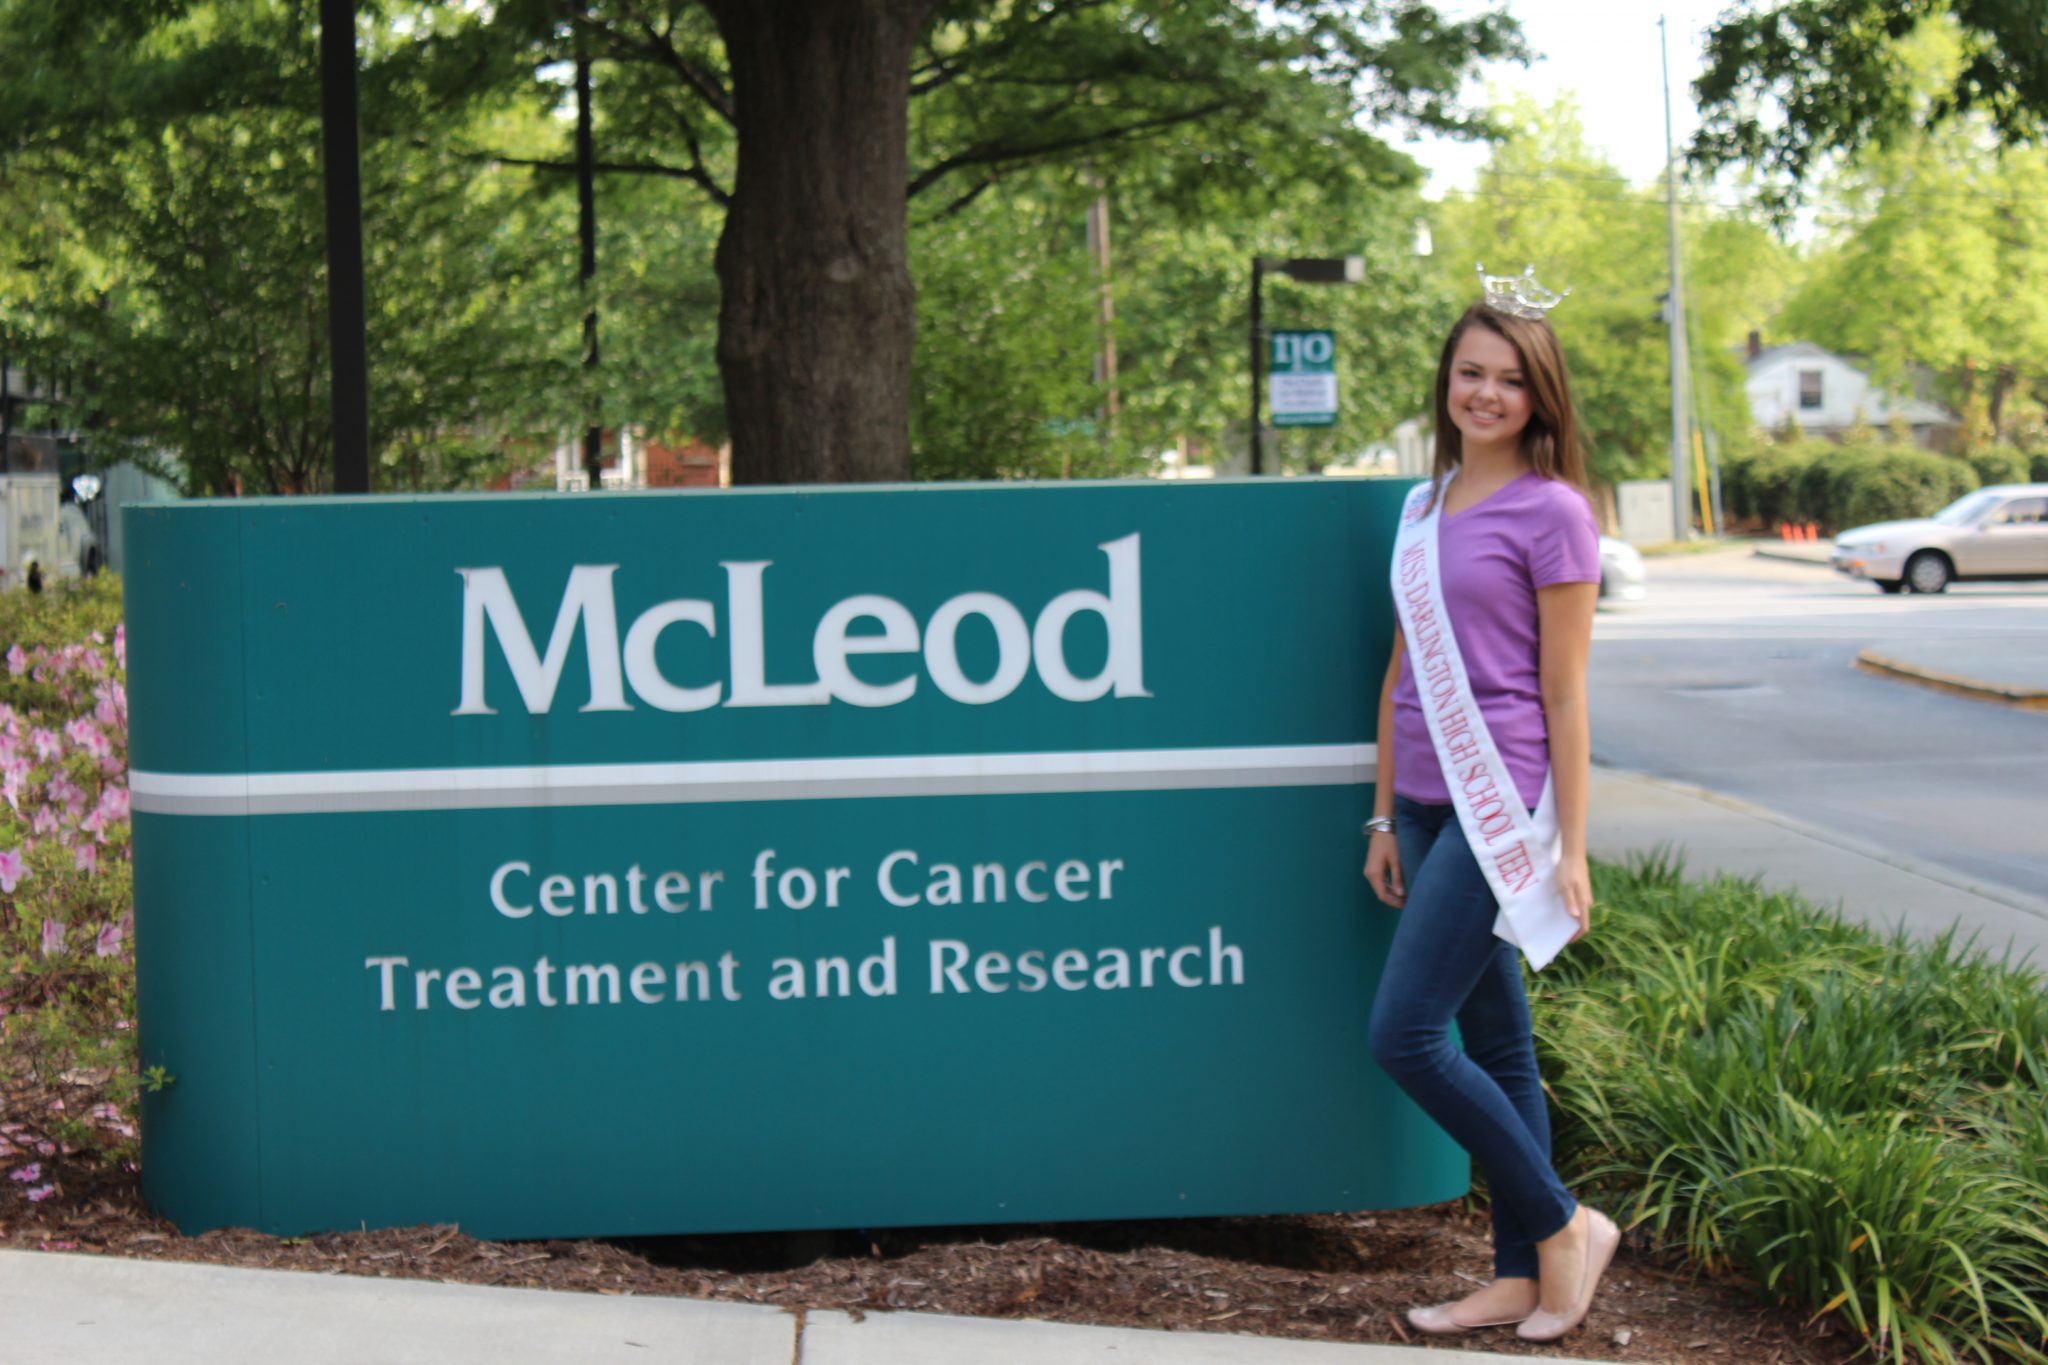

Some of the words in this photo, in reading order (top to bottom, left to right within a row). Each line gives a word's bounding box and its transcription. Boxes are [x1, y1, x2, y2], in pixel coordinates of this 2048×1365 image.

[1401, 538, 1428, 587] MISS
[451, 531, 1152, 716] McLeod
[1405, 581, 1459, 713] DARLINGTON
[1438, 708, 1480, 765] HIGH
[1457, 762, 1516, 847] SCHOOL
[490, 860, 725, 919] Center
[752, 848, 852, 910] for
[876, 849, 1124, 908] Cancer
[1493, 840, 1541, 895] TEEN
[365, 953, 742, 1012] Treatment
[768, 936, 898, 1001] and
[928, 926, 1245, 994] Research
